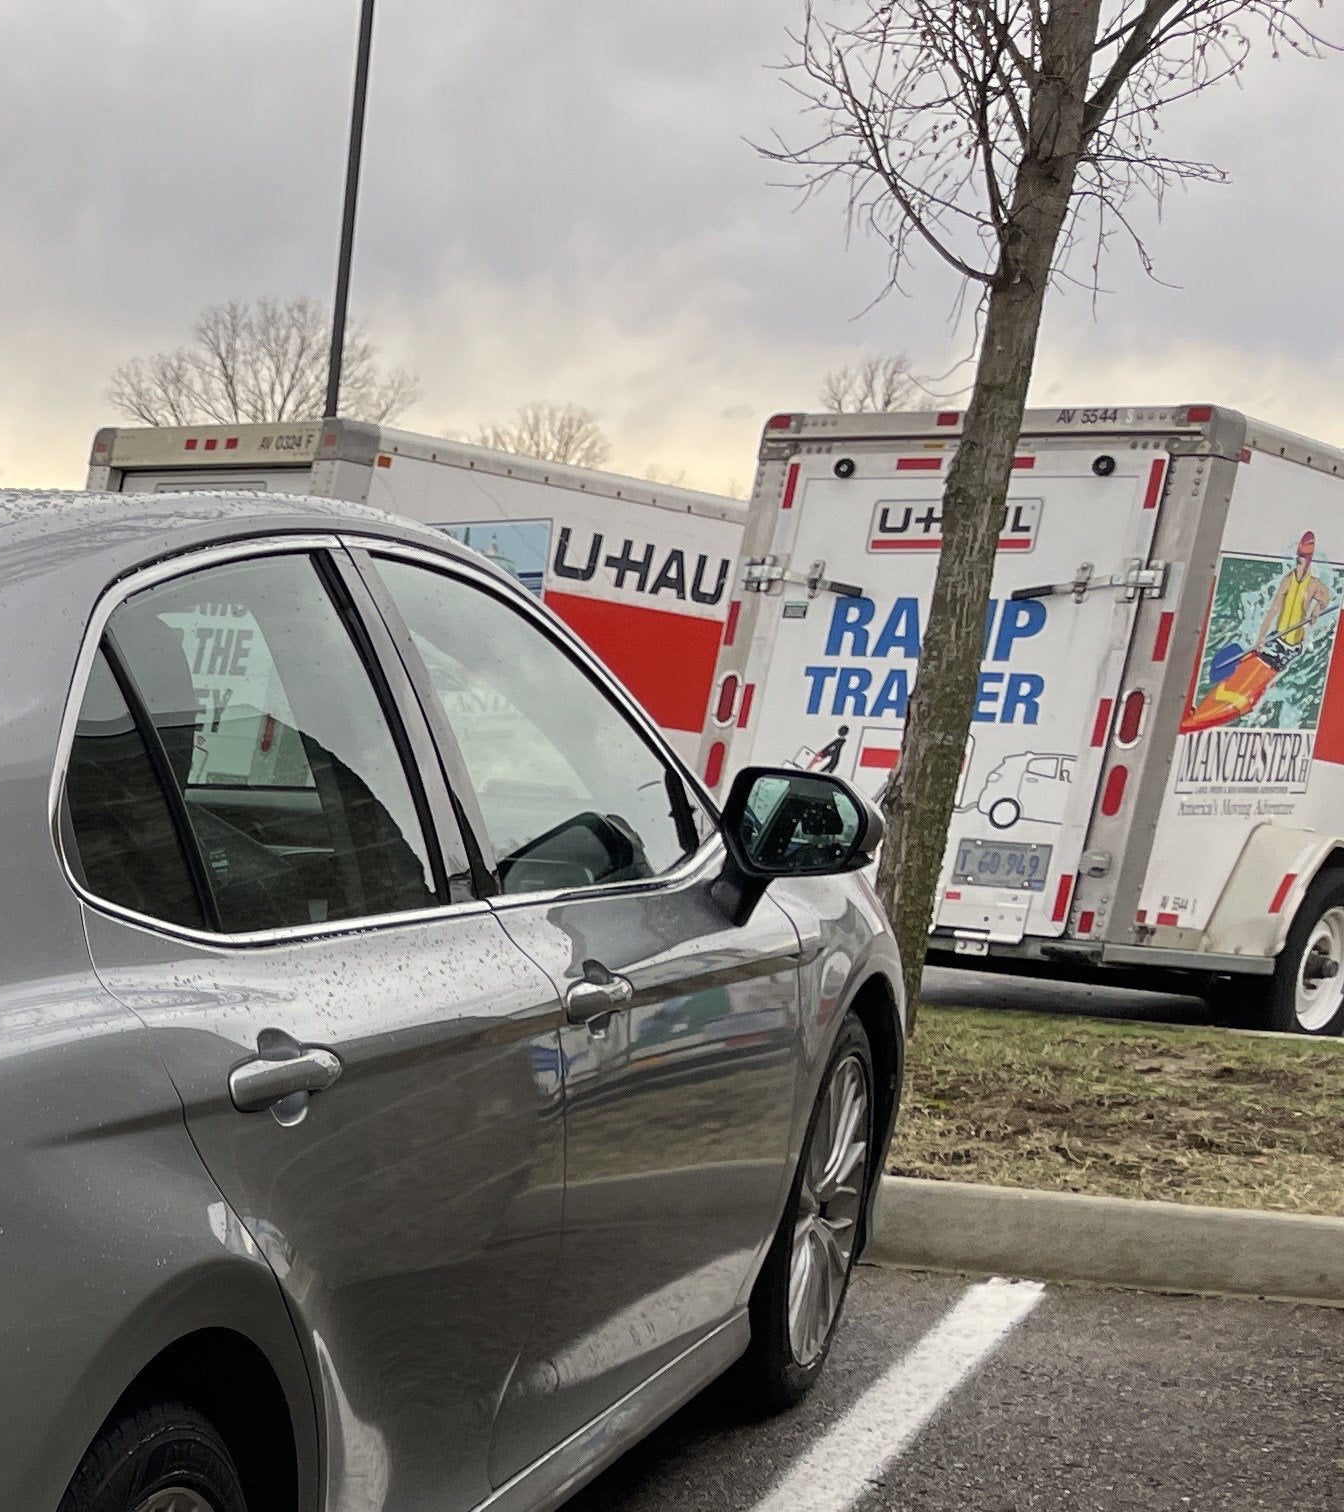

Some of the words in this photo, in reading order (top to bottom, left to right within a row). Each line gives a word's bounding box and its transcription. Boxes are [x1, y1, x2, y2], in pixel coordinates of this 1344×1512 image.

[1056, 408, 1078, 424] AV
[1081, 408, 1120, 424] 5544
[553, 526, 731, 606] U-HAU
[192, 627, 254, 676] THE
[824, 596, 1048, 662] RAP
[804, 665, 1045, 726] TRAER
[1176, 731, 1303, 783] MANCHESTER
